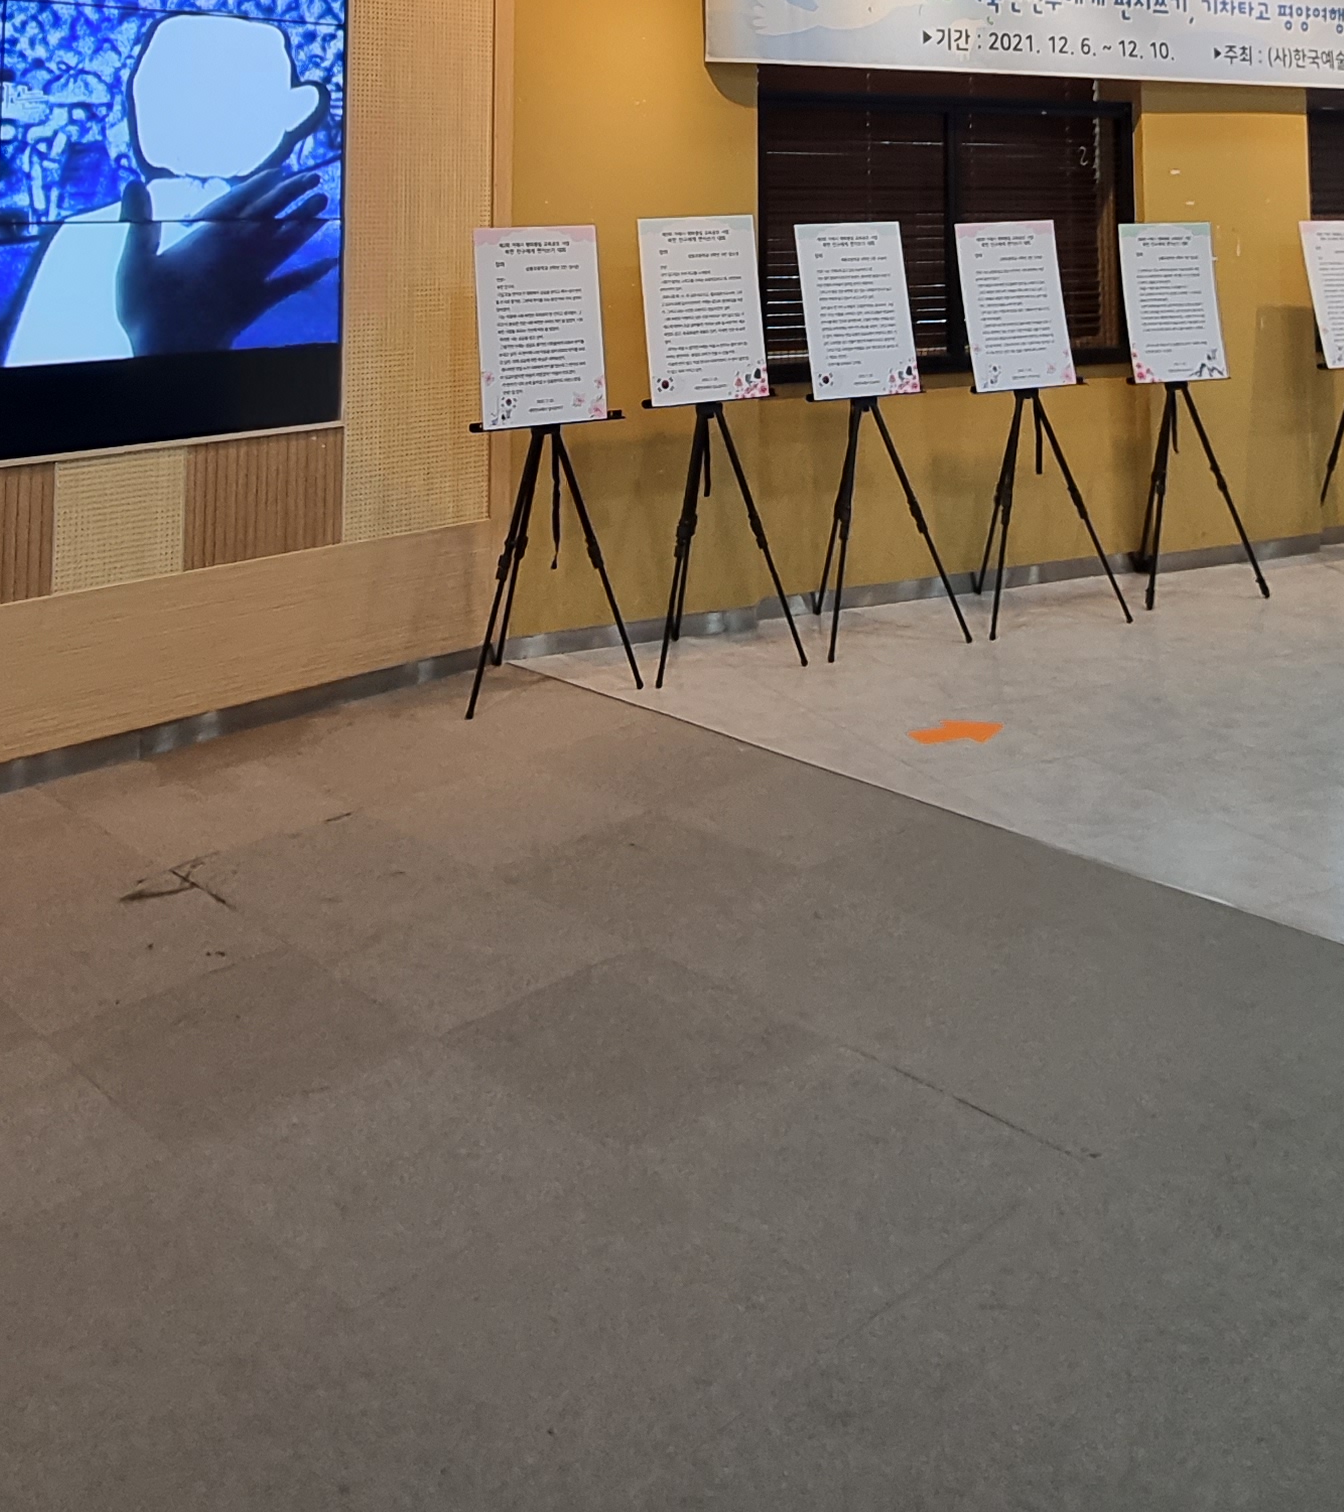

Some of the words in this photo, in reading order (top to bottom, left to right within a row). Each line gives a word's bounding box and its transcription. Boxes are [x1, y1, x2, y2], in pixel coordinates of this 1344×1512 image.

[935, 28, 971, 52] 기간
[988, 31, 1041, 54] 2021.
[1047, 35, 1075, 55] 12.
[1080, 37, 1097, 57] 6.
[1118, 39, 1144, 59] 12.
[1149, 41, 1175, 61] 10.
